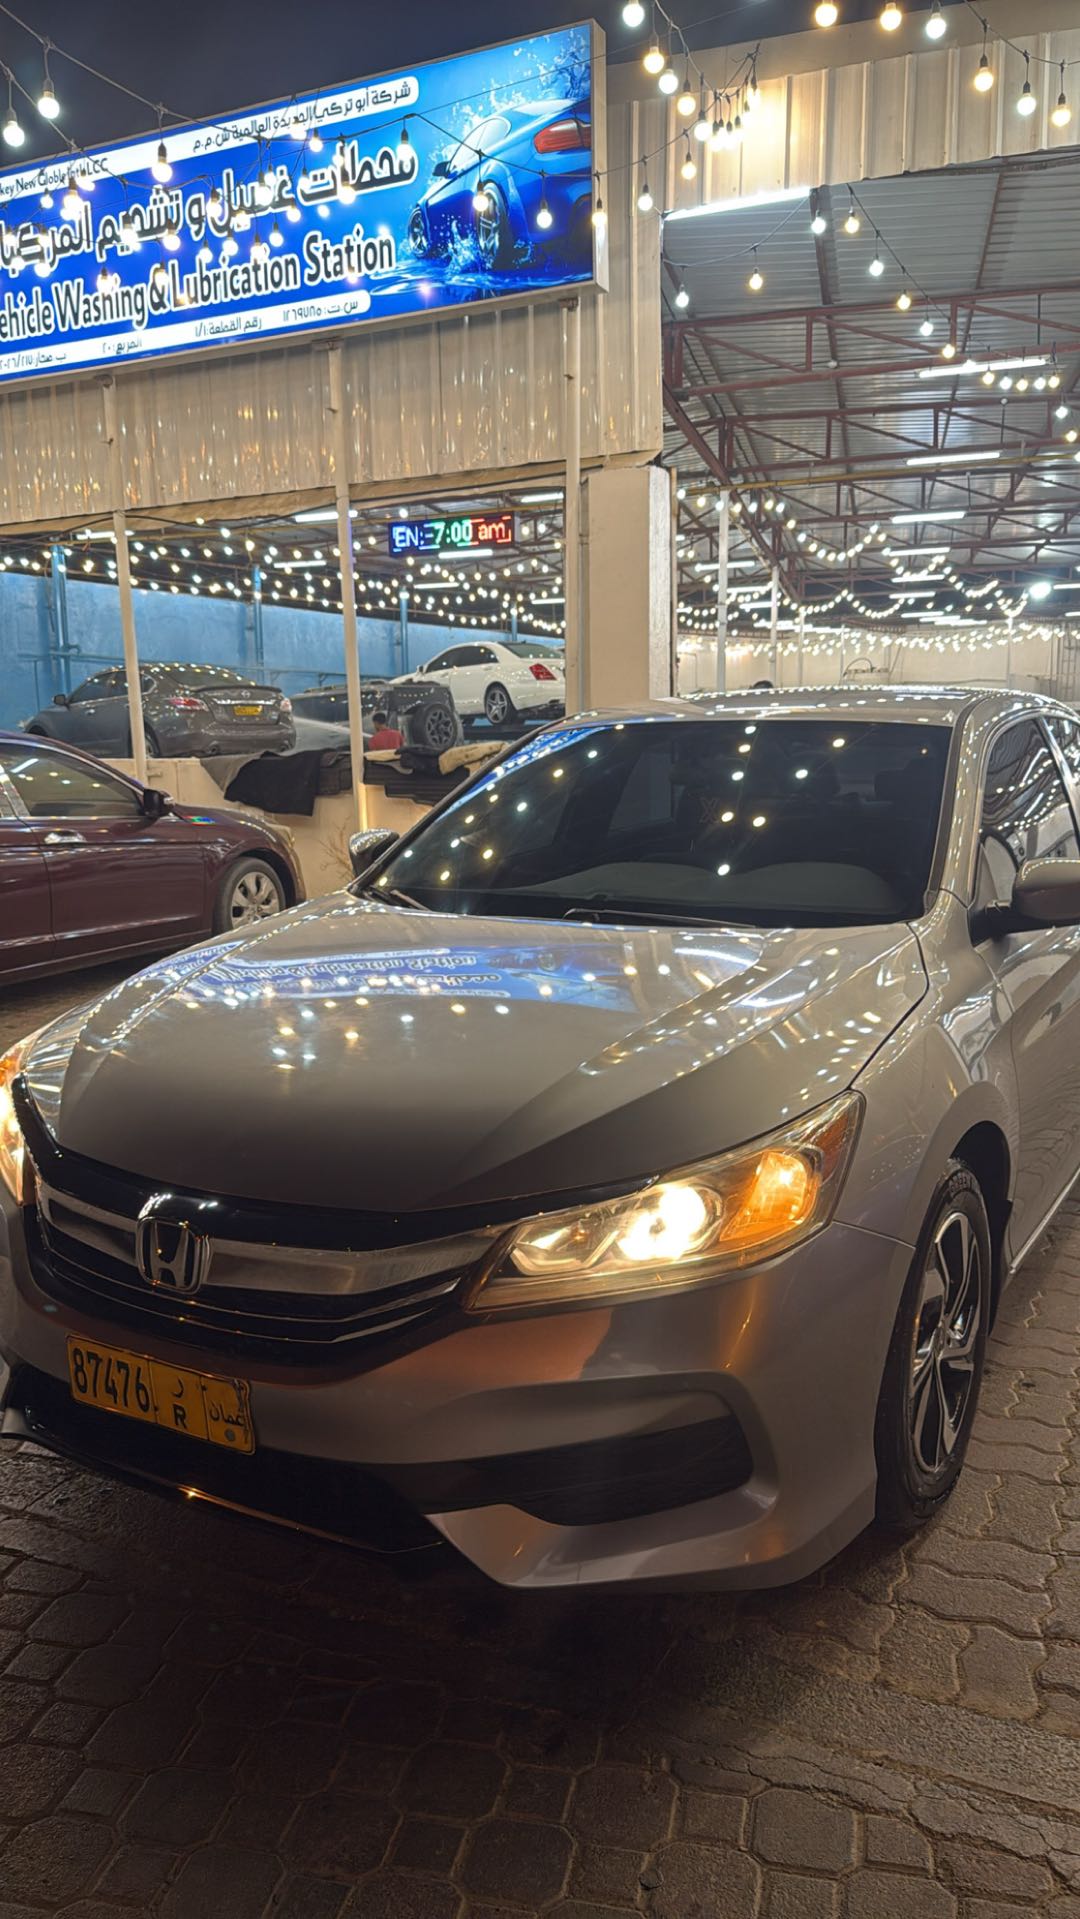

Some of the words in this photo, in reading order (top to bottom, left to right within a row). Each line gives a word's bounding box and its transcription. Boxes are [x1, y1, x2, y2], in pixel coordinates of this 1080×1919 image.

[355, 86, 369, 113] أبو
[372, 81, 411, 104] شركة
[16, 177, 37, 192] New
[187, 197, 203, 235] و
[55, 277, 145, 327] Washing
[150, 263, 168, 312] &
[171, 248, 298, 308] Lubrication
[306, 227, 393, 283] Station
[478, 521, 506, 540] am
[72, 1347, 151, 1413] 87476
[173, 1403, 188, 1429] R
[209, 1401, 245, 1427] عمان
